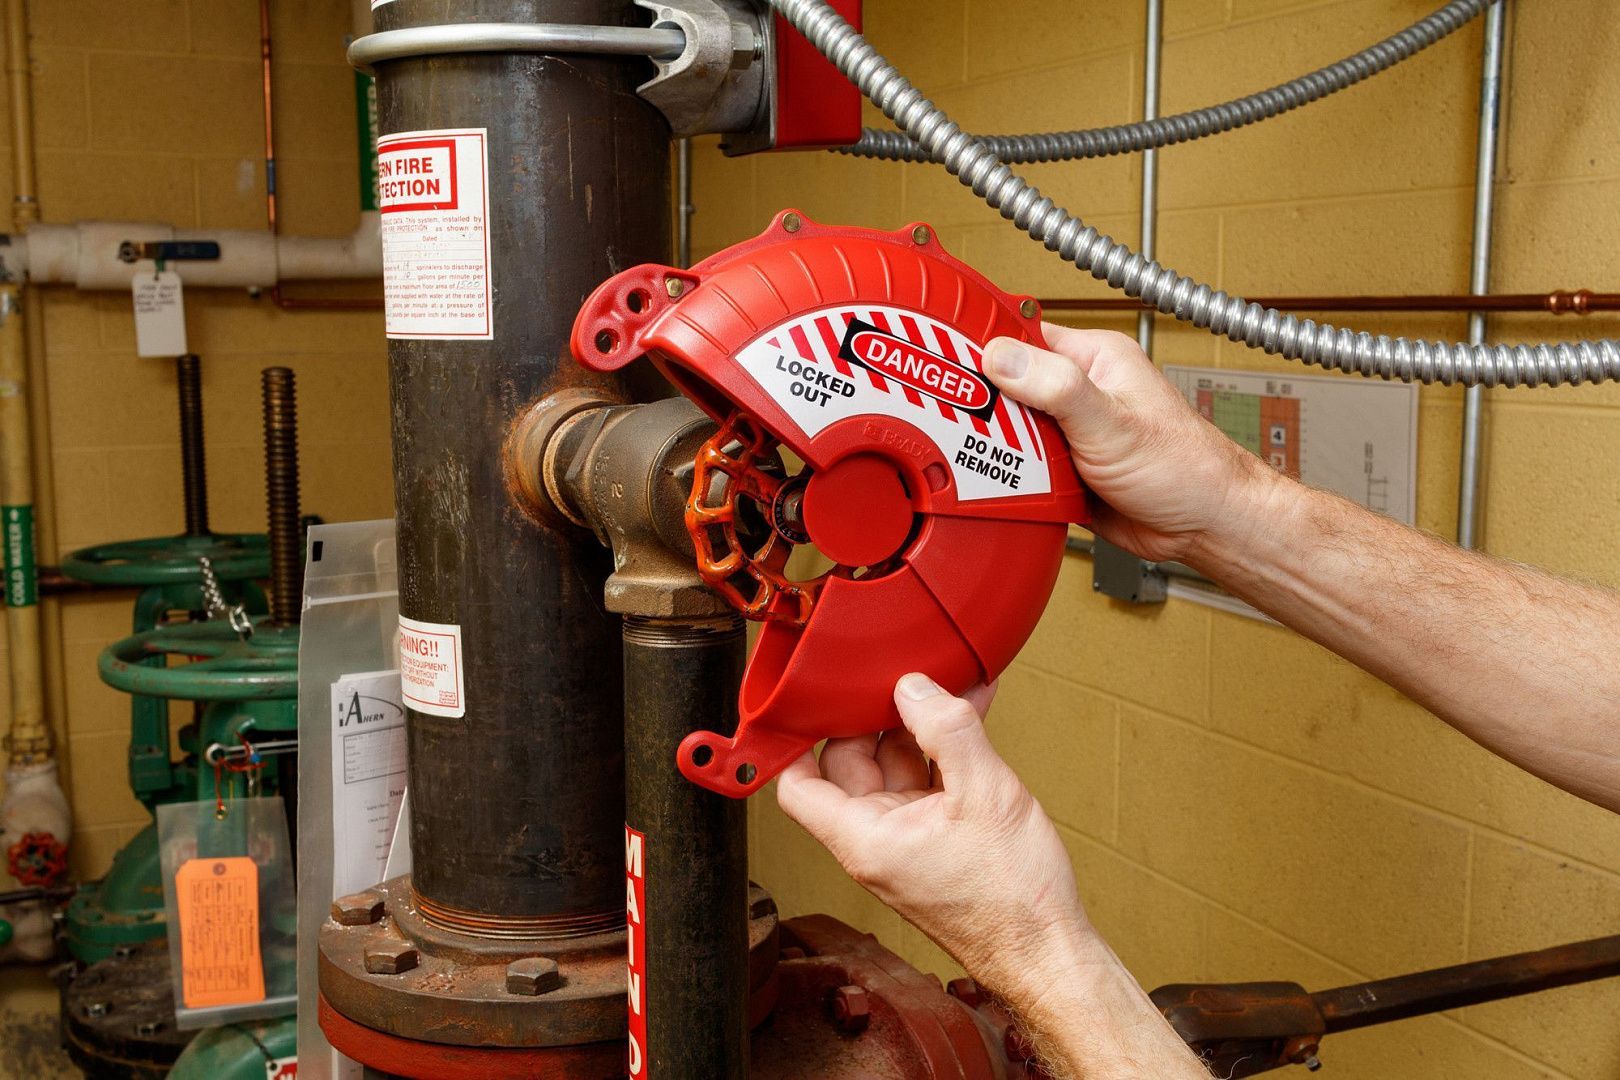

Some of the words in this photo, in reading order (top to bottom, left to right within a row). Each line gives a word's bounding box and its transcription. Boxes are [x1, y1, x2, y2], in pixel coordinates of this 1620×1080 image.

[396, 157, 433, 175] FIRE
[452, 263, 483, 271] discharge
[776, 355, 856, 399] LOCKED
[866, 338, 976, 403] DANGER
[790, 381, 832, 408] OUT
[963, 434, 988, 457] DO
[990, 442, 1024, 471] NOT
[954, 452, 1022, 490] REMOVE
[345, 691, 384, 726] AHERN
